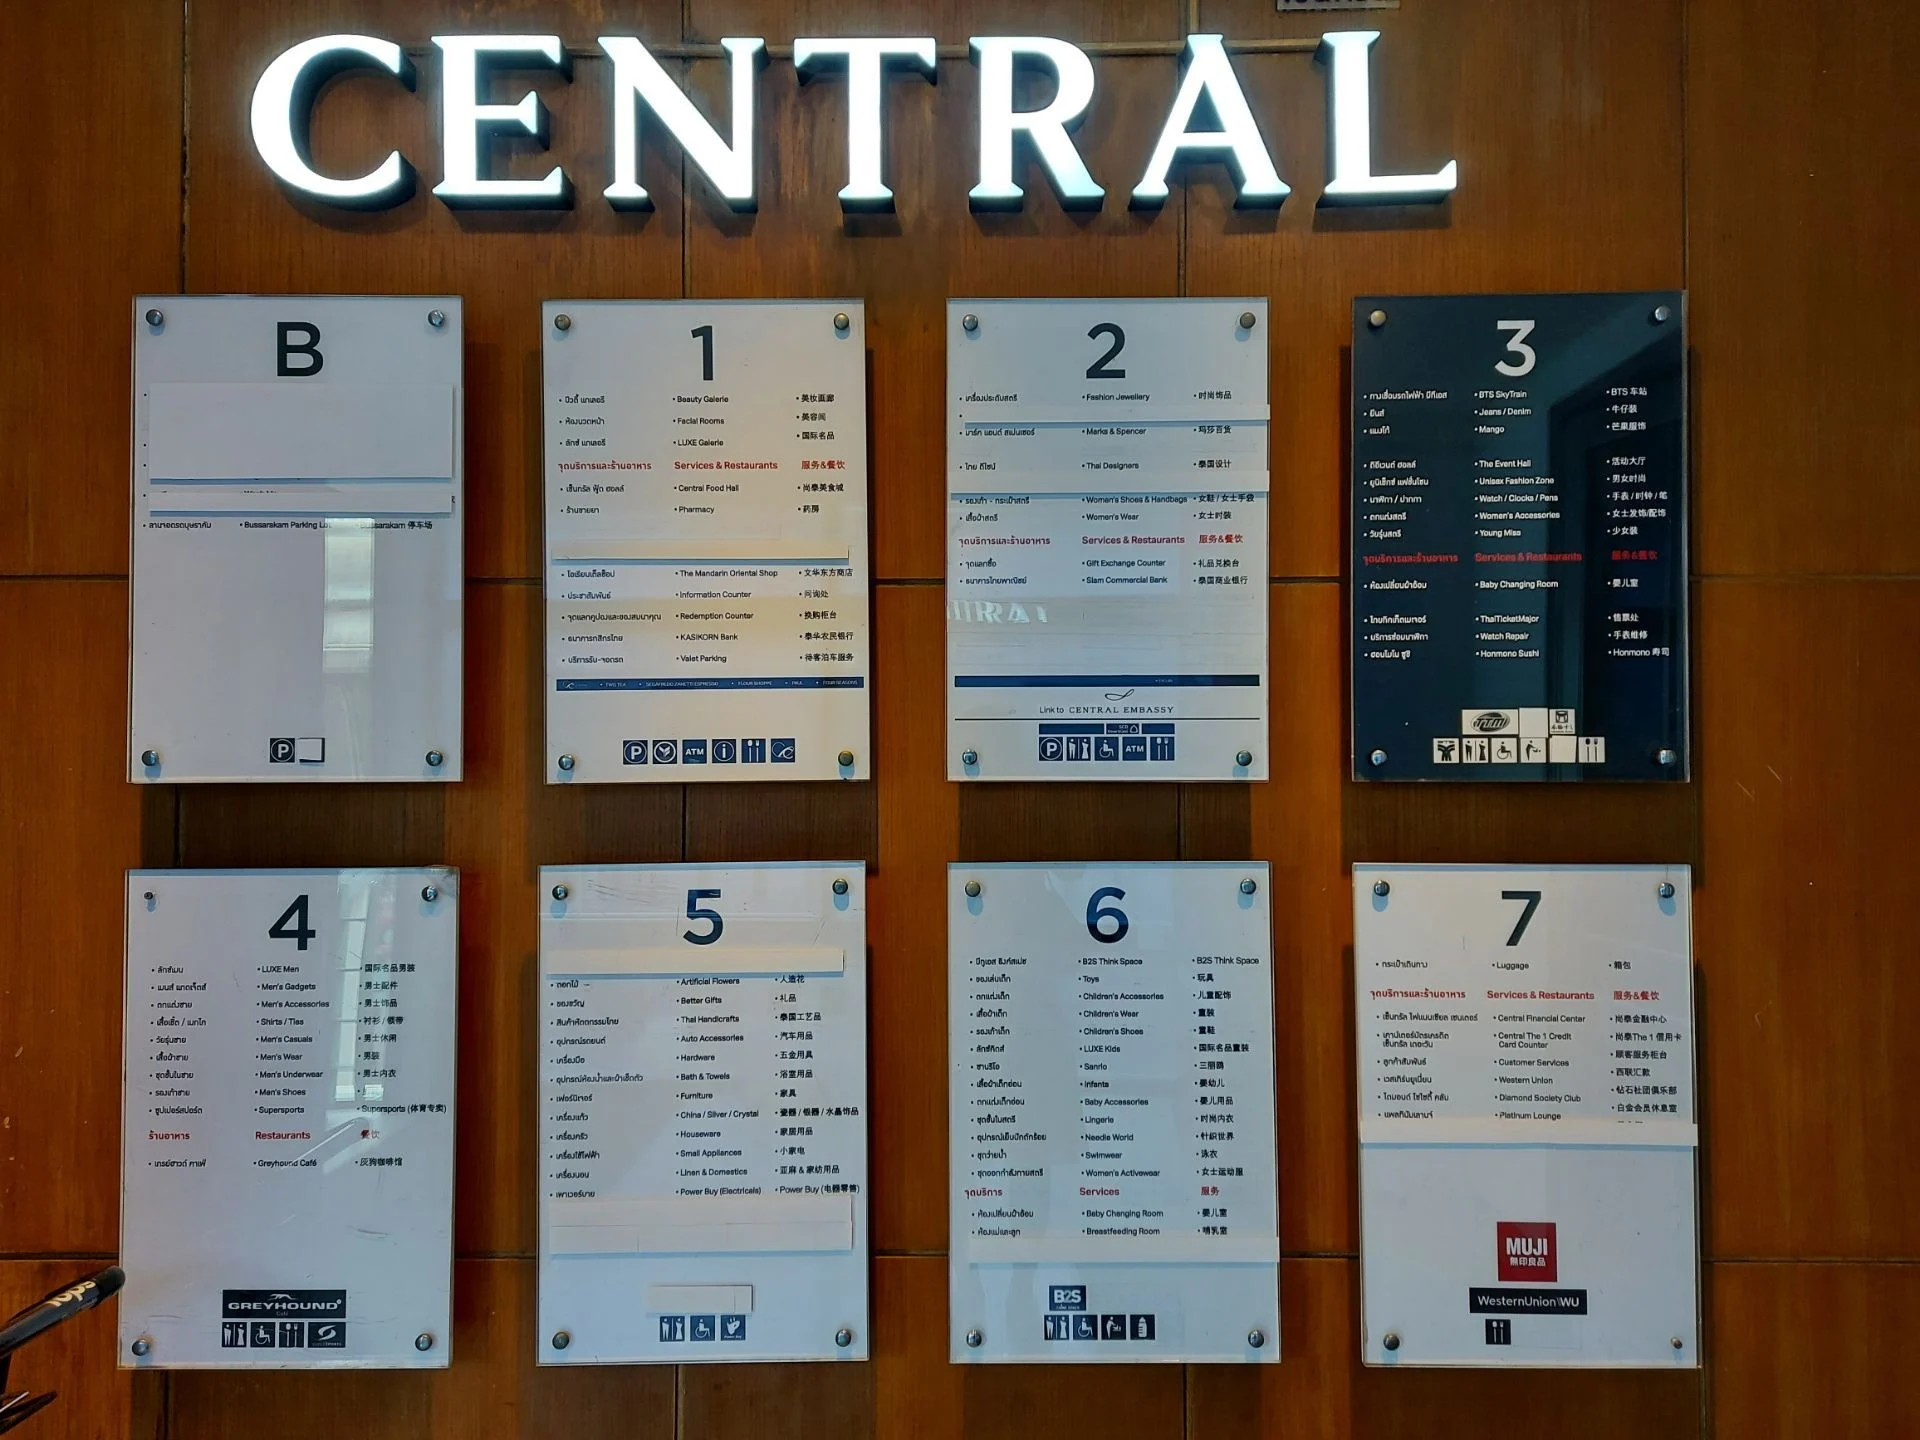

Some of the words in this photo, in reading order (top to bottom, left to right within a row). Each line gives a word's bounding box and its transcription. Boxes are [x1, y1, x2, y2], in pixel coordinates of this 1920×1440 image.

[251, 32, 1456, 198] CENTRAL
[277, 322, 323, 376] B
[691, 326, 713, 380] 1
[1086, 323, 1125, 378] 2
[1495, 320, 1535, 376] 3
[1108, 428, 1116, 437] &
[674, 461, 714, 470] Services
[714, 461, 723, 469] &
[723, 461, 778, 469] Restaurants
[801, 460, 845, 470] 服务&餐饮
[1082, 536, 1122, 544] Services
[1122, 536, 1131, 544] &
[1130, 536, 1185, 544] Restaurants
[720, 633, 738, 641] Bank
[1040, 706, 1056, 714] Link
[1056, 706, 1064, 714] to
[1069, 706, 1119, 714] CENTRAL
[1124, 706, 1174, 714] EMBASSY
[684, 890, 723, 945] 5
[1087, 887, 1128, 943] 6
[1502, 891, 1541, 946] 7
[269, 895, 315, 950] 4
[1487, 990, 1528, 999] Services
[1529, 991, 1537, 999] &
[1537, 991, 1594, 1000] Restaurants
[1614, 991, 1660, 1000] 服务&餐饮
[255, 1131, 311, 1140] Restaurants
[1080, 1187, 1120, 1196] Services
[1201, 1186, 1219, 1196] 服务
[1506, 1238, 1548, 1255] MUJI
[1054, 1290, 1081, 1303] B2S
[228, 1302, 337, 1310] GREYHOUND
